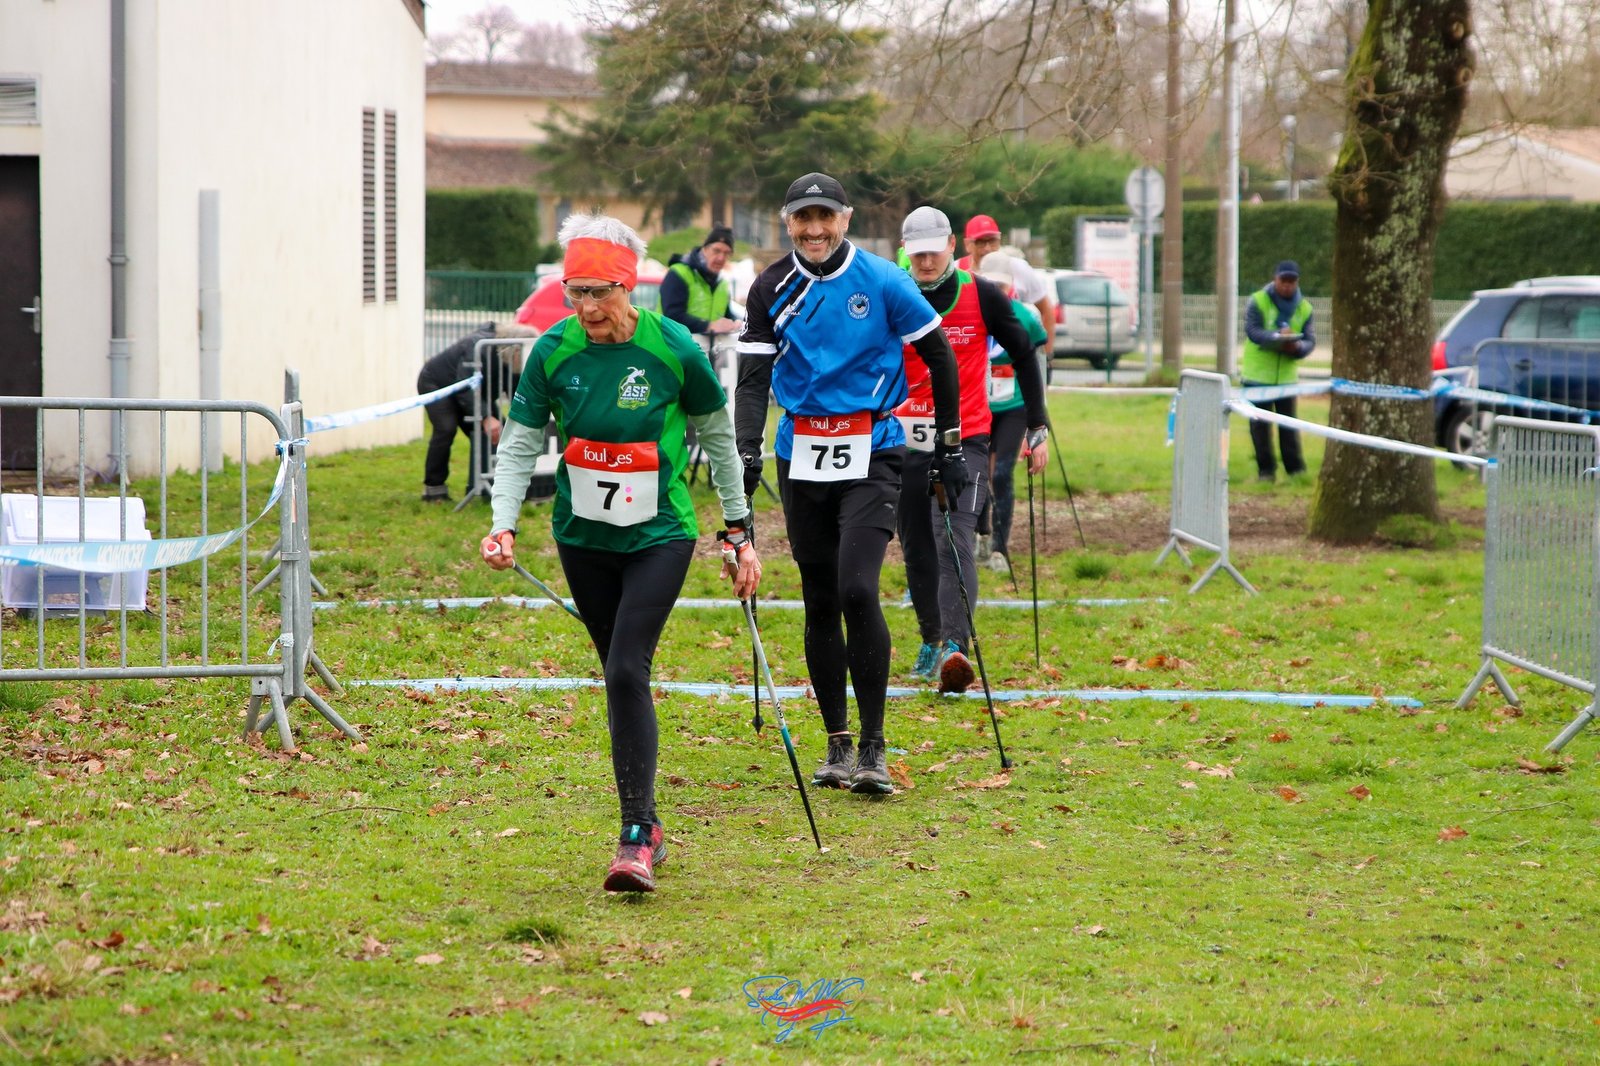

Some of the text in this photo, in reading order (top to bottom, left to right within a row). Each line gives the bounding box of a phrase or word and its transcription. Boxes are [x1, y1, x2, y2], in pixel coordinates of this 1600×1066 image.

[621, 385, 649, 398] ASF
[810, 443, 852, 470] 75
[596, 480, 621, 511] 7
